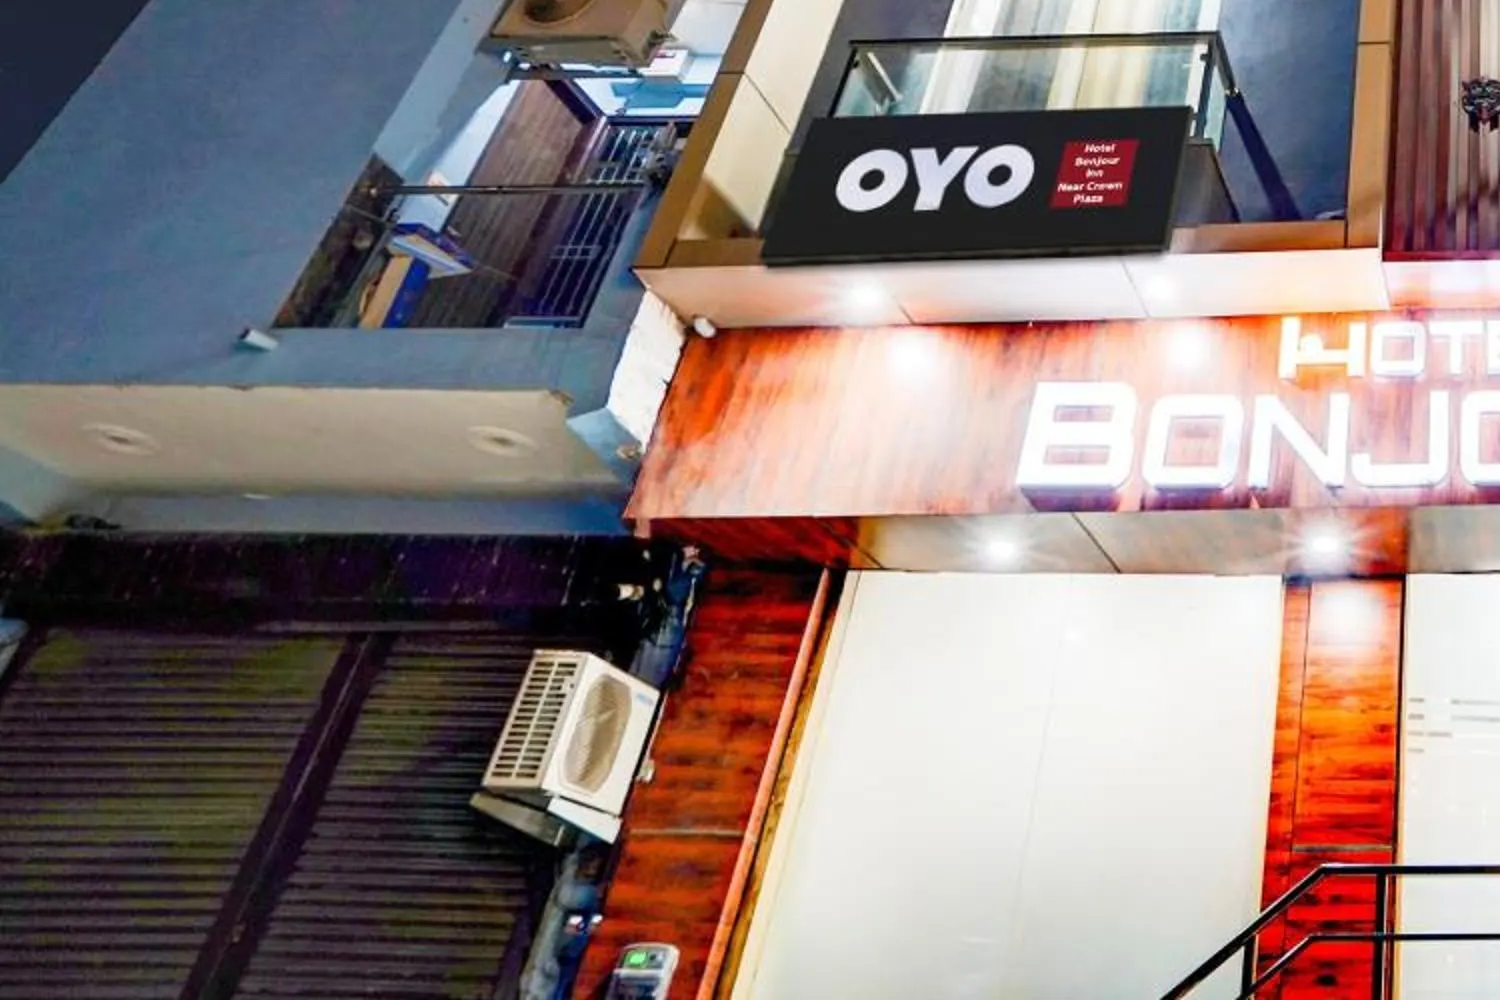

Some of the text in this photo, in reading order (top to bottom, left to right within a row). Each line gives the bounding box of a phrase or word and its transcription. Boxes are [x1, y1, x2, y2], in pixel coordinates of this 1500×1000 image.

[1084, 143, 1116, 153] Hotel
[836, 144, 1035, 212] OYO
[1086, 169, 1104, 178] Inn
[1058, 181, 1123, 192] Near Crown
[1073, 194, 1104, 204] Plaza
